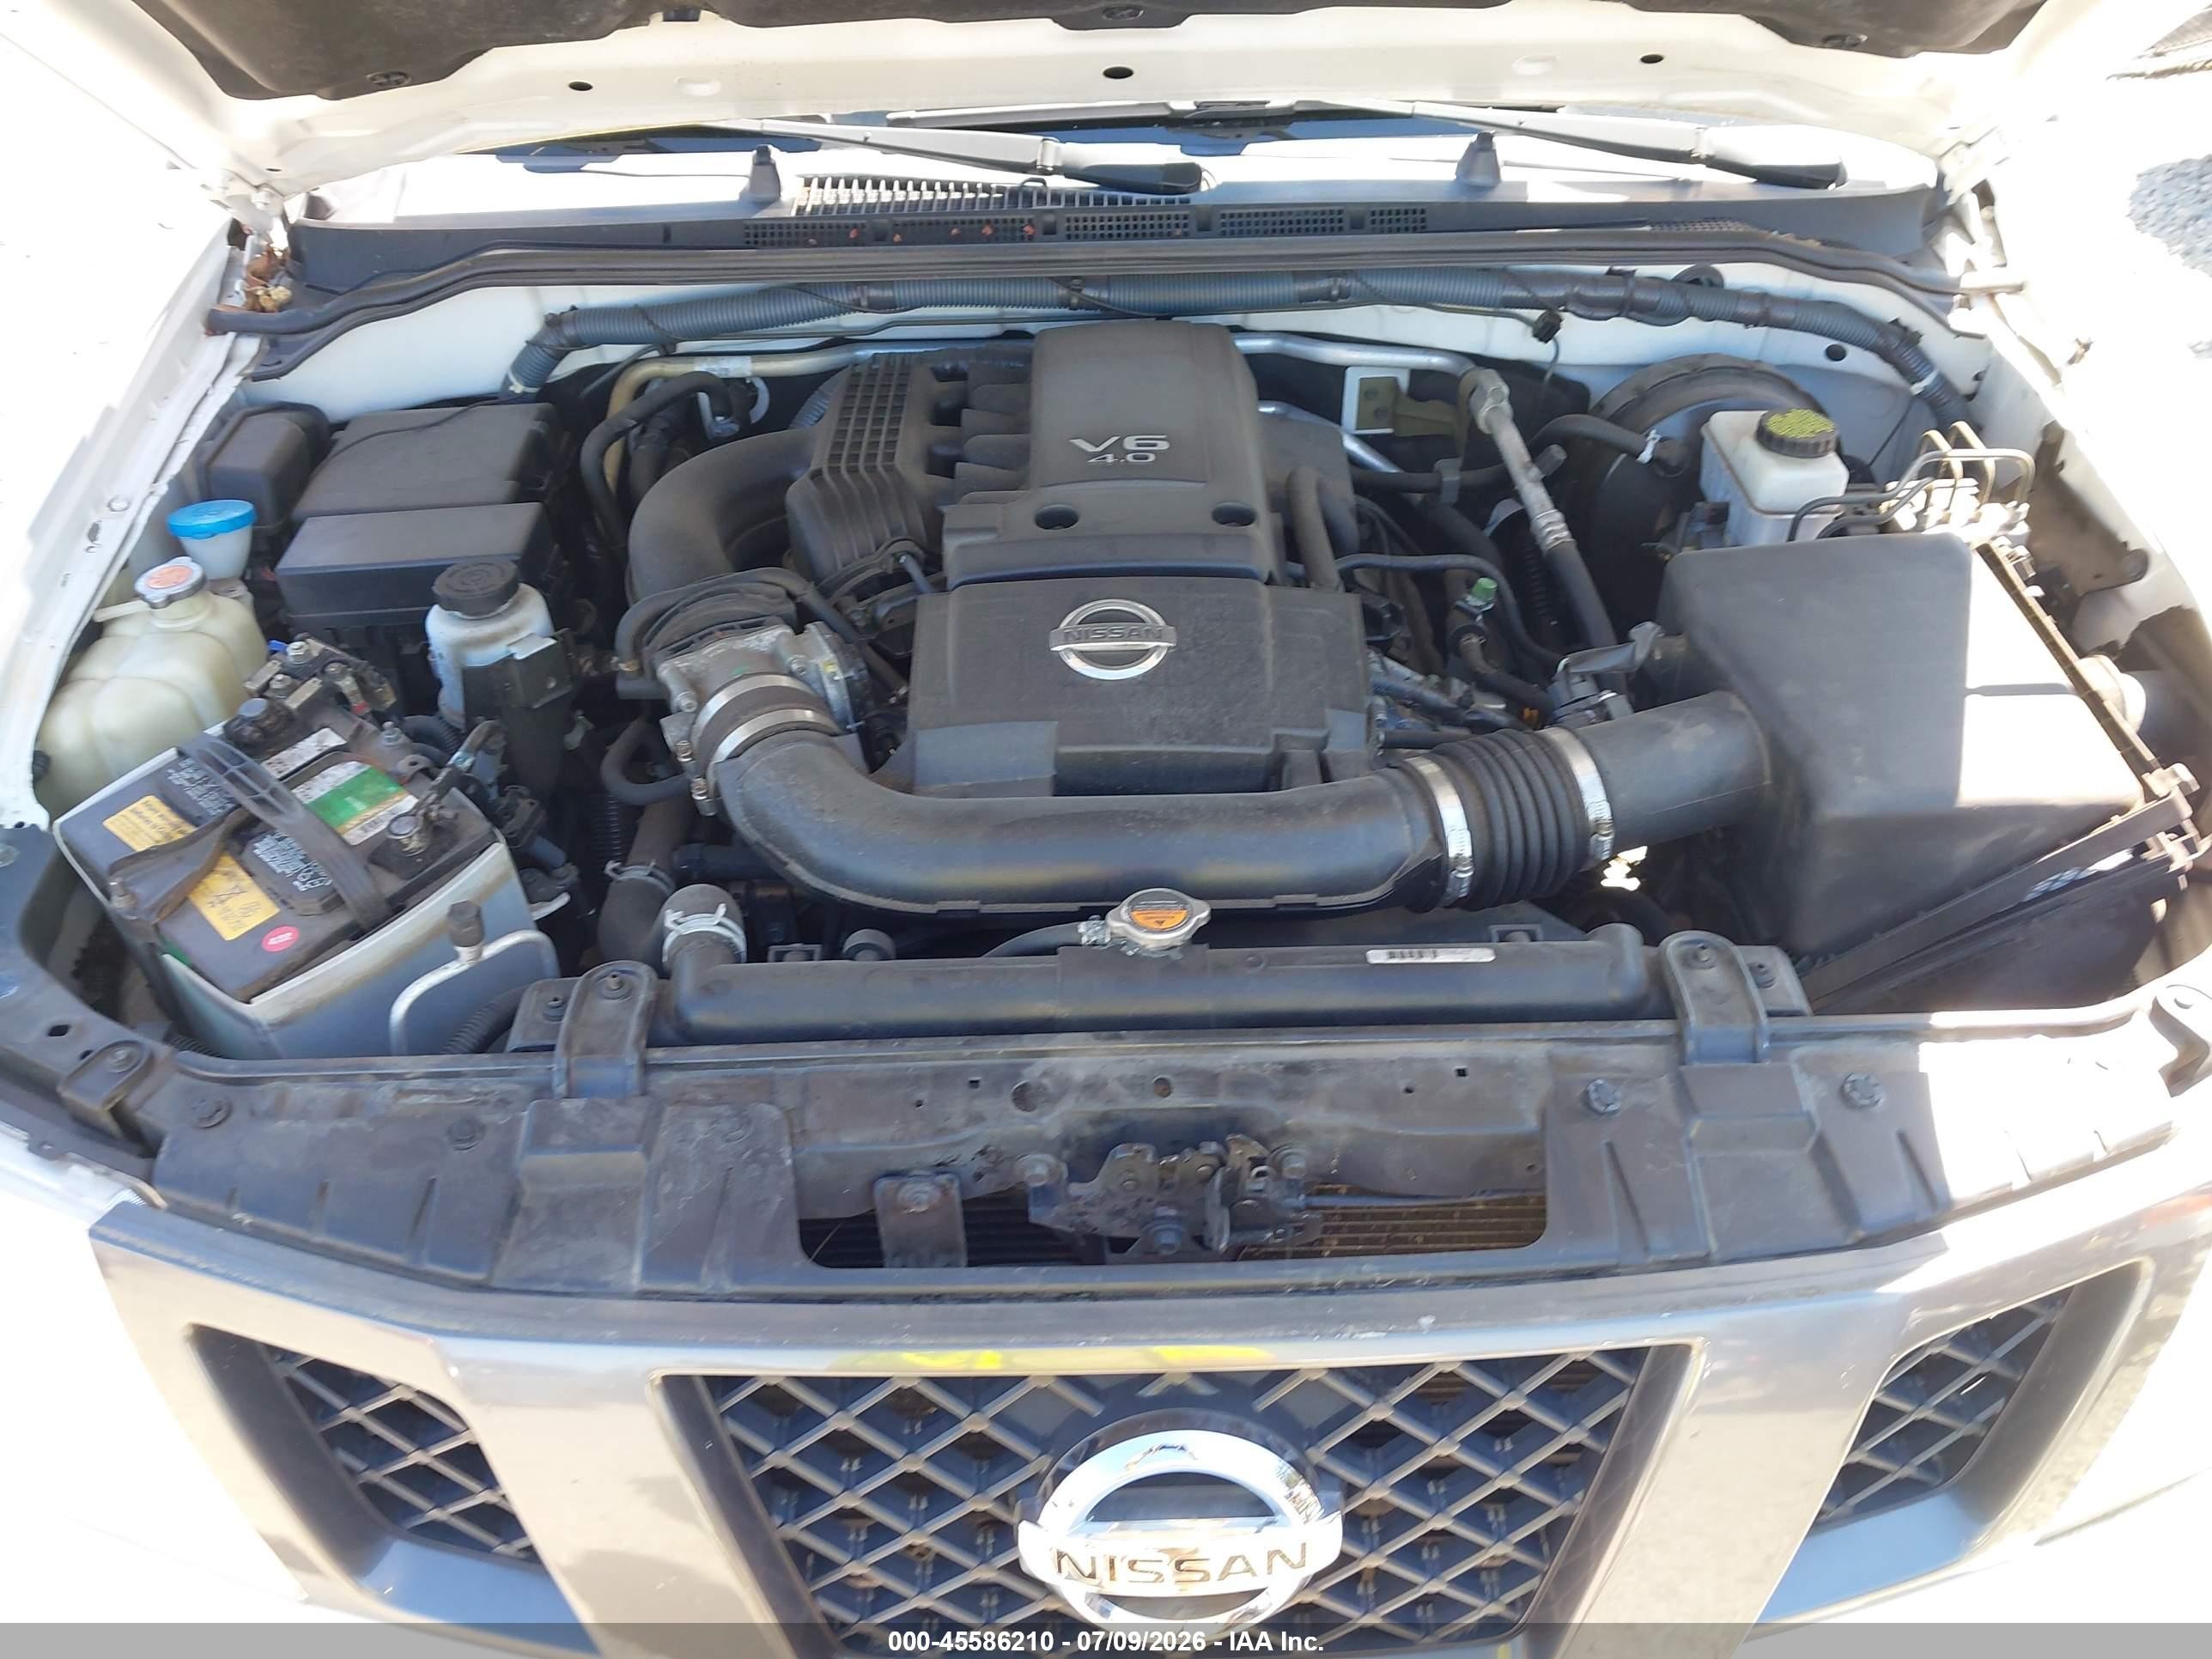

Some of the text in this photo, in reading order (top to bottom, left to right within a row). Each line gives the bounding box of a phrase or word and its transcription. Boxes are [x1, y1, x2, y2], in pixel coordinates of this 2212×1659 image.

[1070, 434, 1170, 453] V6
[1087, 452, 1156, 464] 4.0
[1063, 626, 1164, 641] NISSAN
[1053, 1542, 1307, 1587] NISSAN
